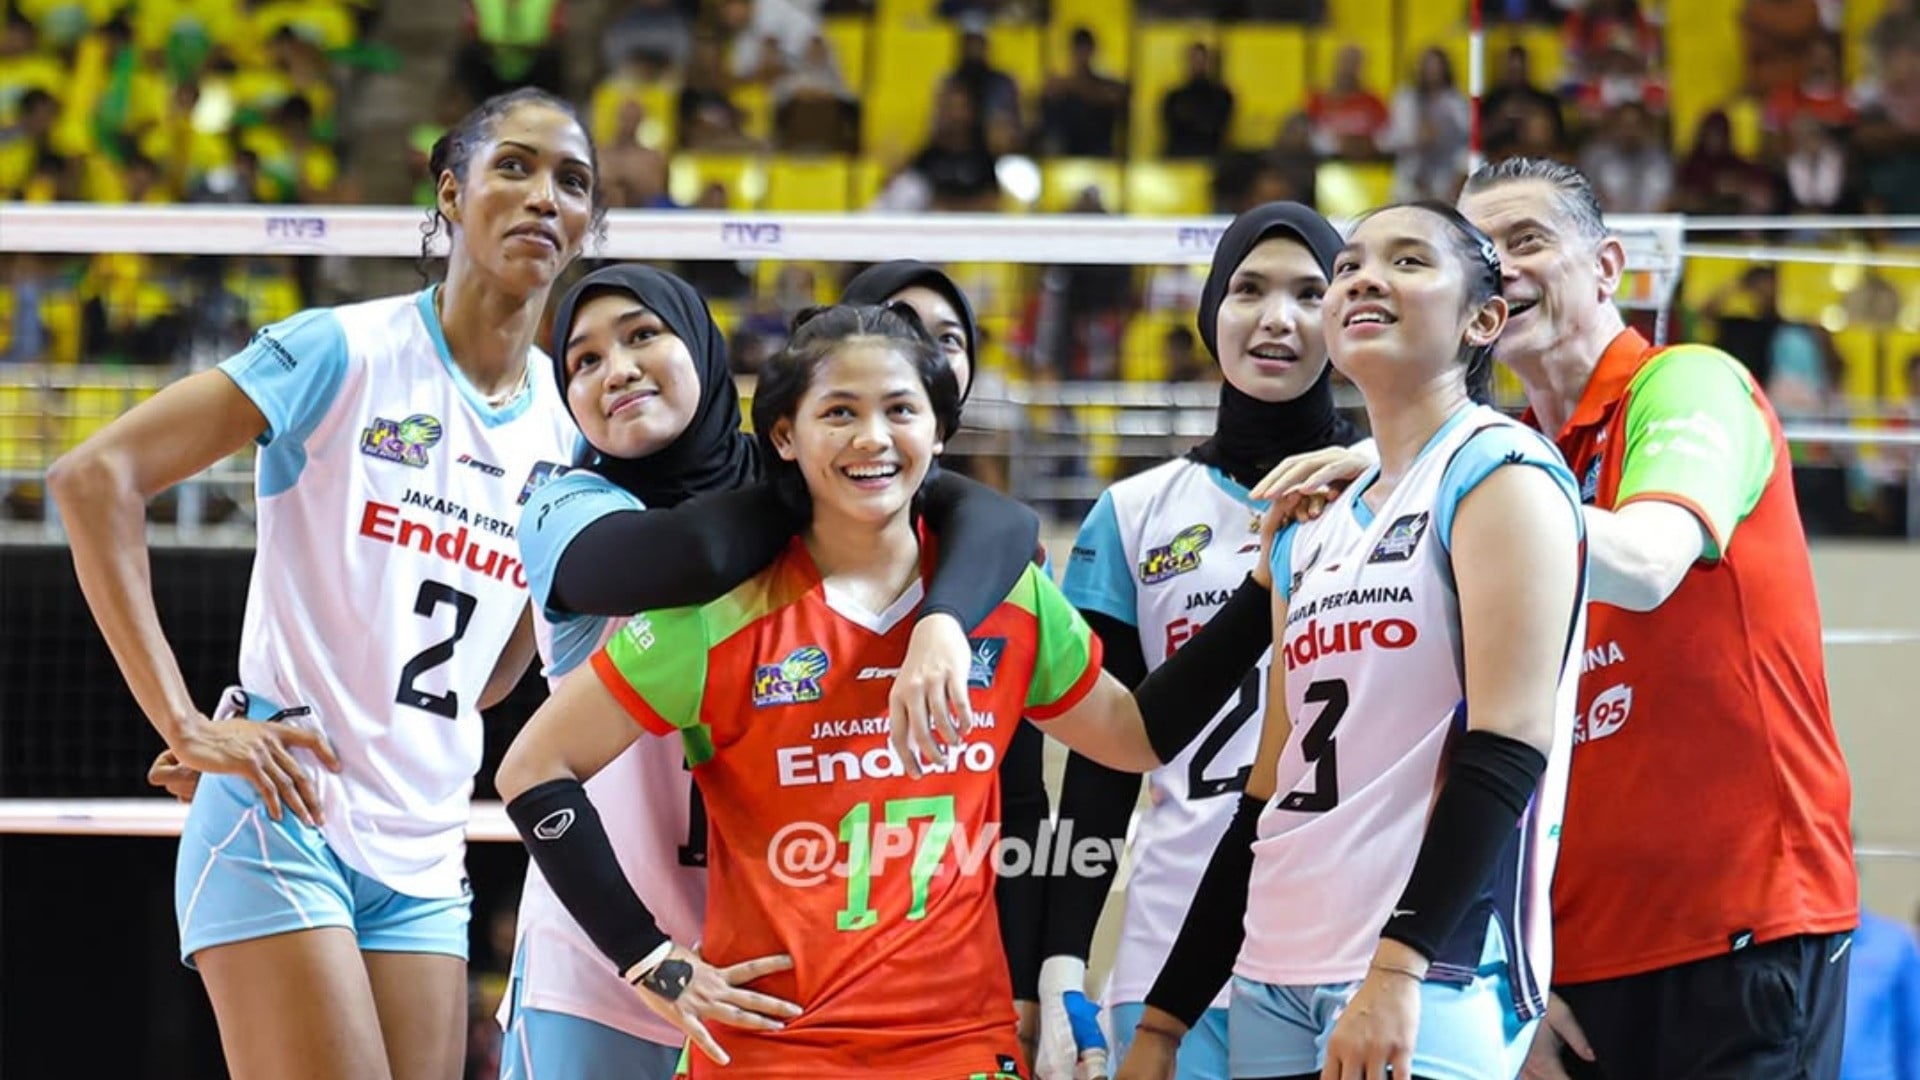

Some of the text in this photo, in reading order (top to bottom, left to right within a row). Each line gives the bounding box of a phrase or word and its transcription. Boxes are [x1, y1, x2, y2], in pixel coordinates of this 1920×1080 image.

[401, 488, 515, 540] JAKARTA PERTA
[1185, 588, 1238, 611] JAKA
[395, 579, 478, 720] 2
[1277, 678, 1349, 812] 3
[1594, 699, 1626, 729] 95
[837, 795, 955, 931] 17
